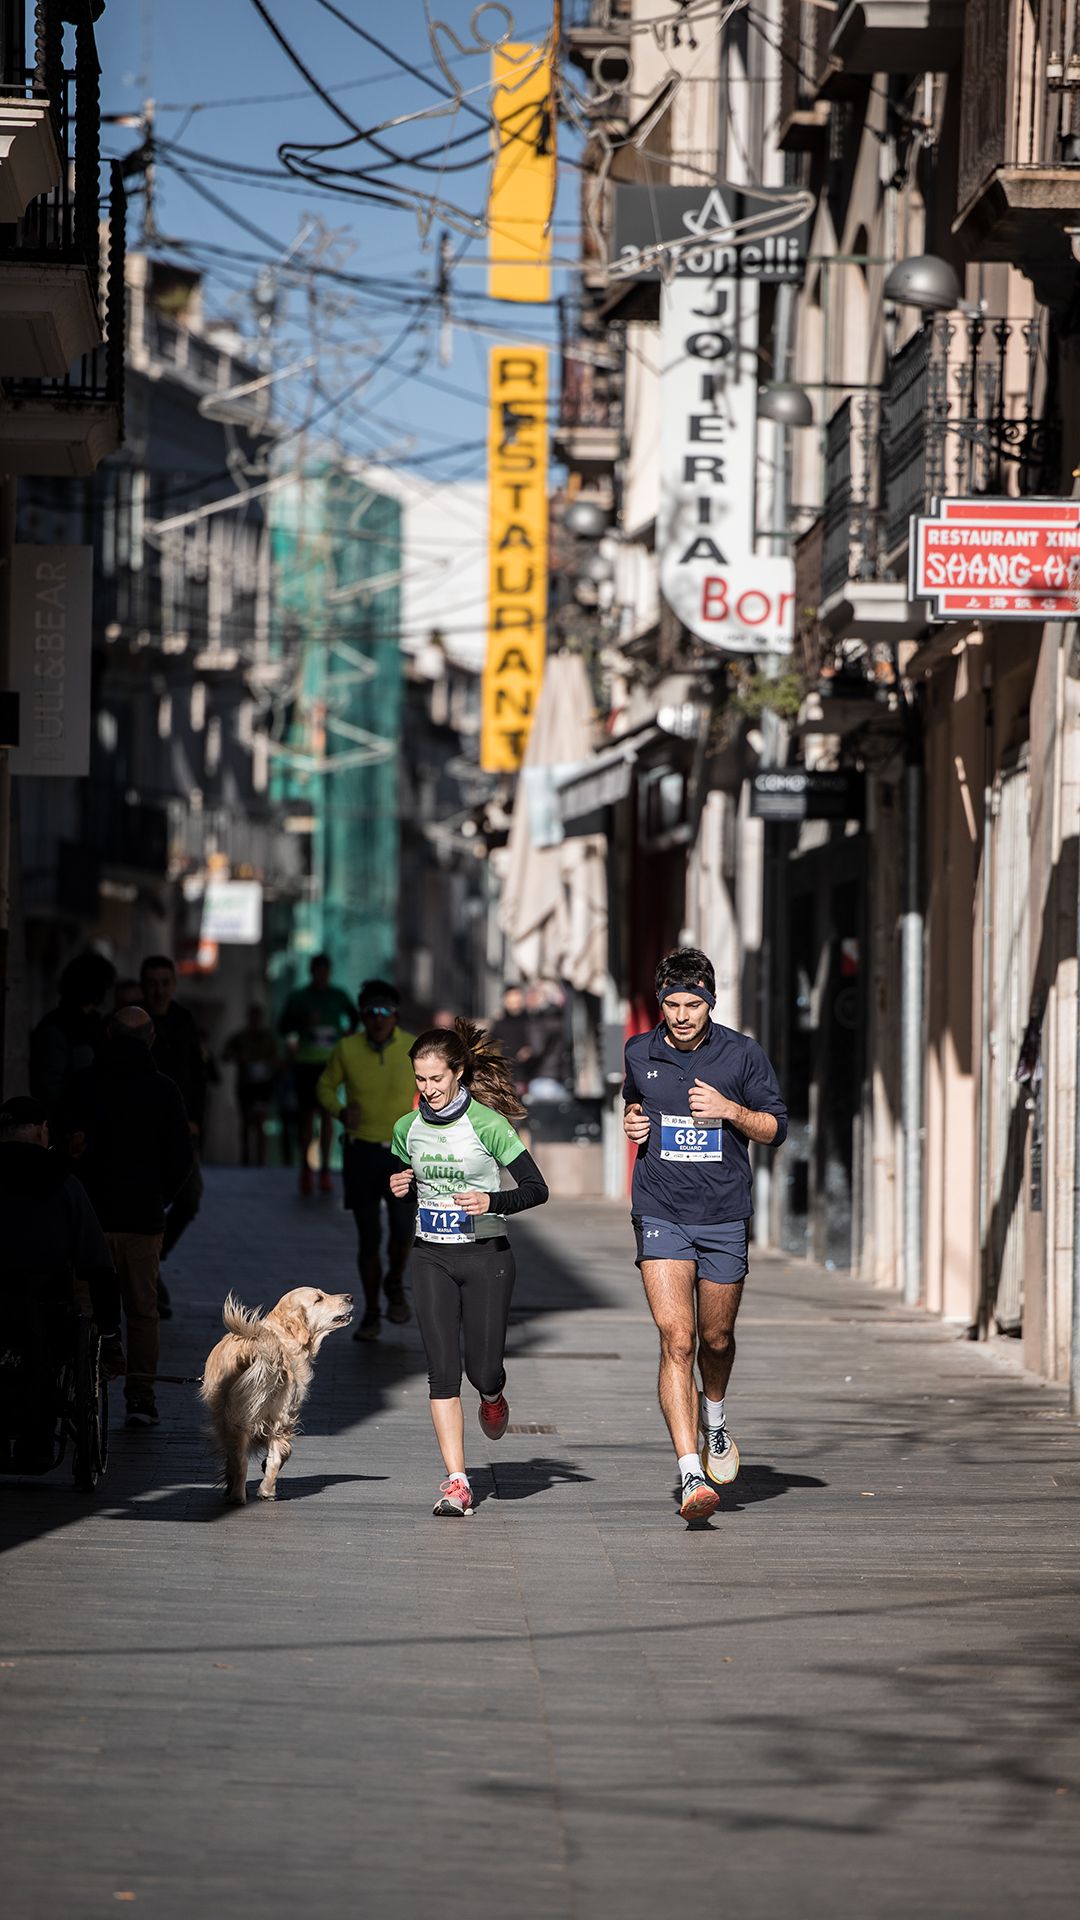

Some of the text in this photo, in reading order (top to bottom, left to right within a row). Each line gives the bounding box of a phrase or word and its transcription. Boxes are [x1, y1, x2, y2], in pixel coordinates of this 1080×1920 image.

[678, 290, 732, 566] JOIERIA
[928, 529, 1080, 547] RESTAURANT XIN
[33, 562, 66, 761] PULL&BEAR
[675, 1130, 708, 1145] 682
[423, 1165, 465, 1182] Mitja
[430, 1211, 460, 1228] 712
